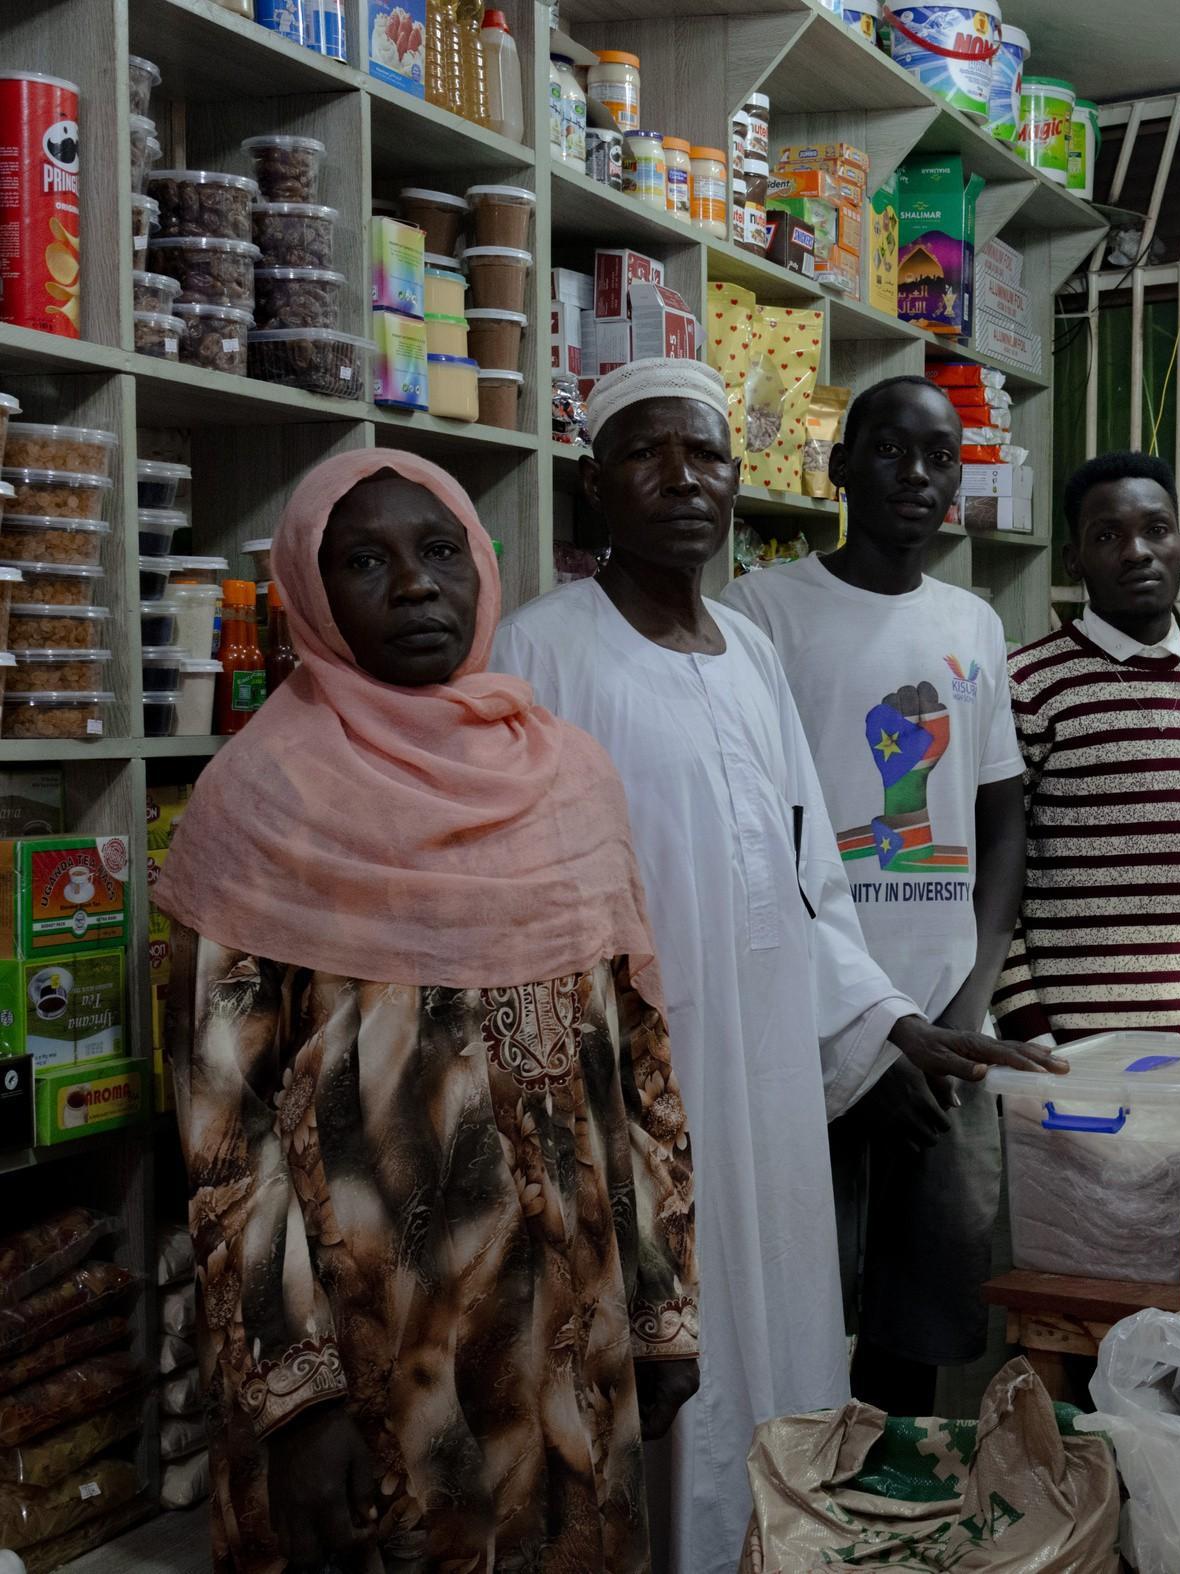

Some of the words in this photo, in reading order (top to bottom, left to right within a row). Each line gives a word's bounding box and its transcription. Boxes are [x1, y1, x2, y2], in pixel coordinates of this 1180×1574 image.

[1018, 117, 1063, 143] Magic
[43, 163, 80, 193] PRING
[767, 179, 790, 190] ident
[900, 211, 942, 219] SHALIMAR
[40, 855, 75, 908] UGANDA
[77, 854, 97, 867] TEA
[849, 882, 881, 903] NITY
[884, 882, 899, 902] IN
[902, 881, 970, 902] DIVERSITY
[81, 994, 102, 1009] Tea
[86, 1082, 131, 1106] AROMA
